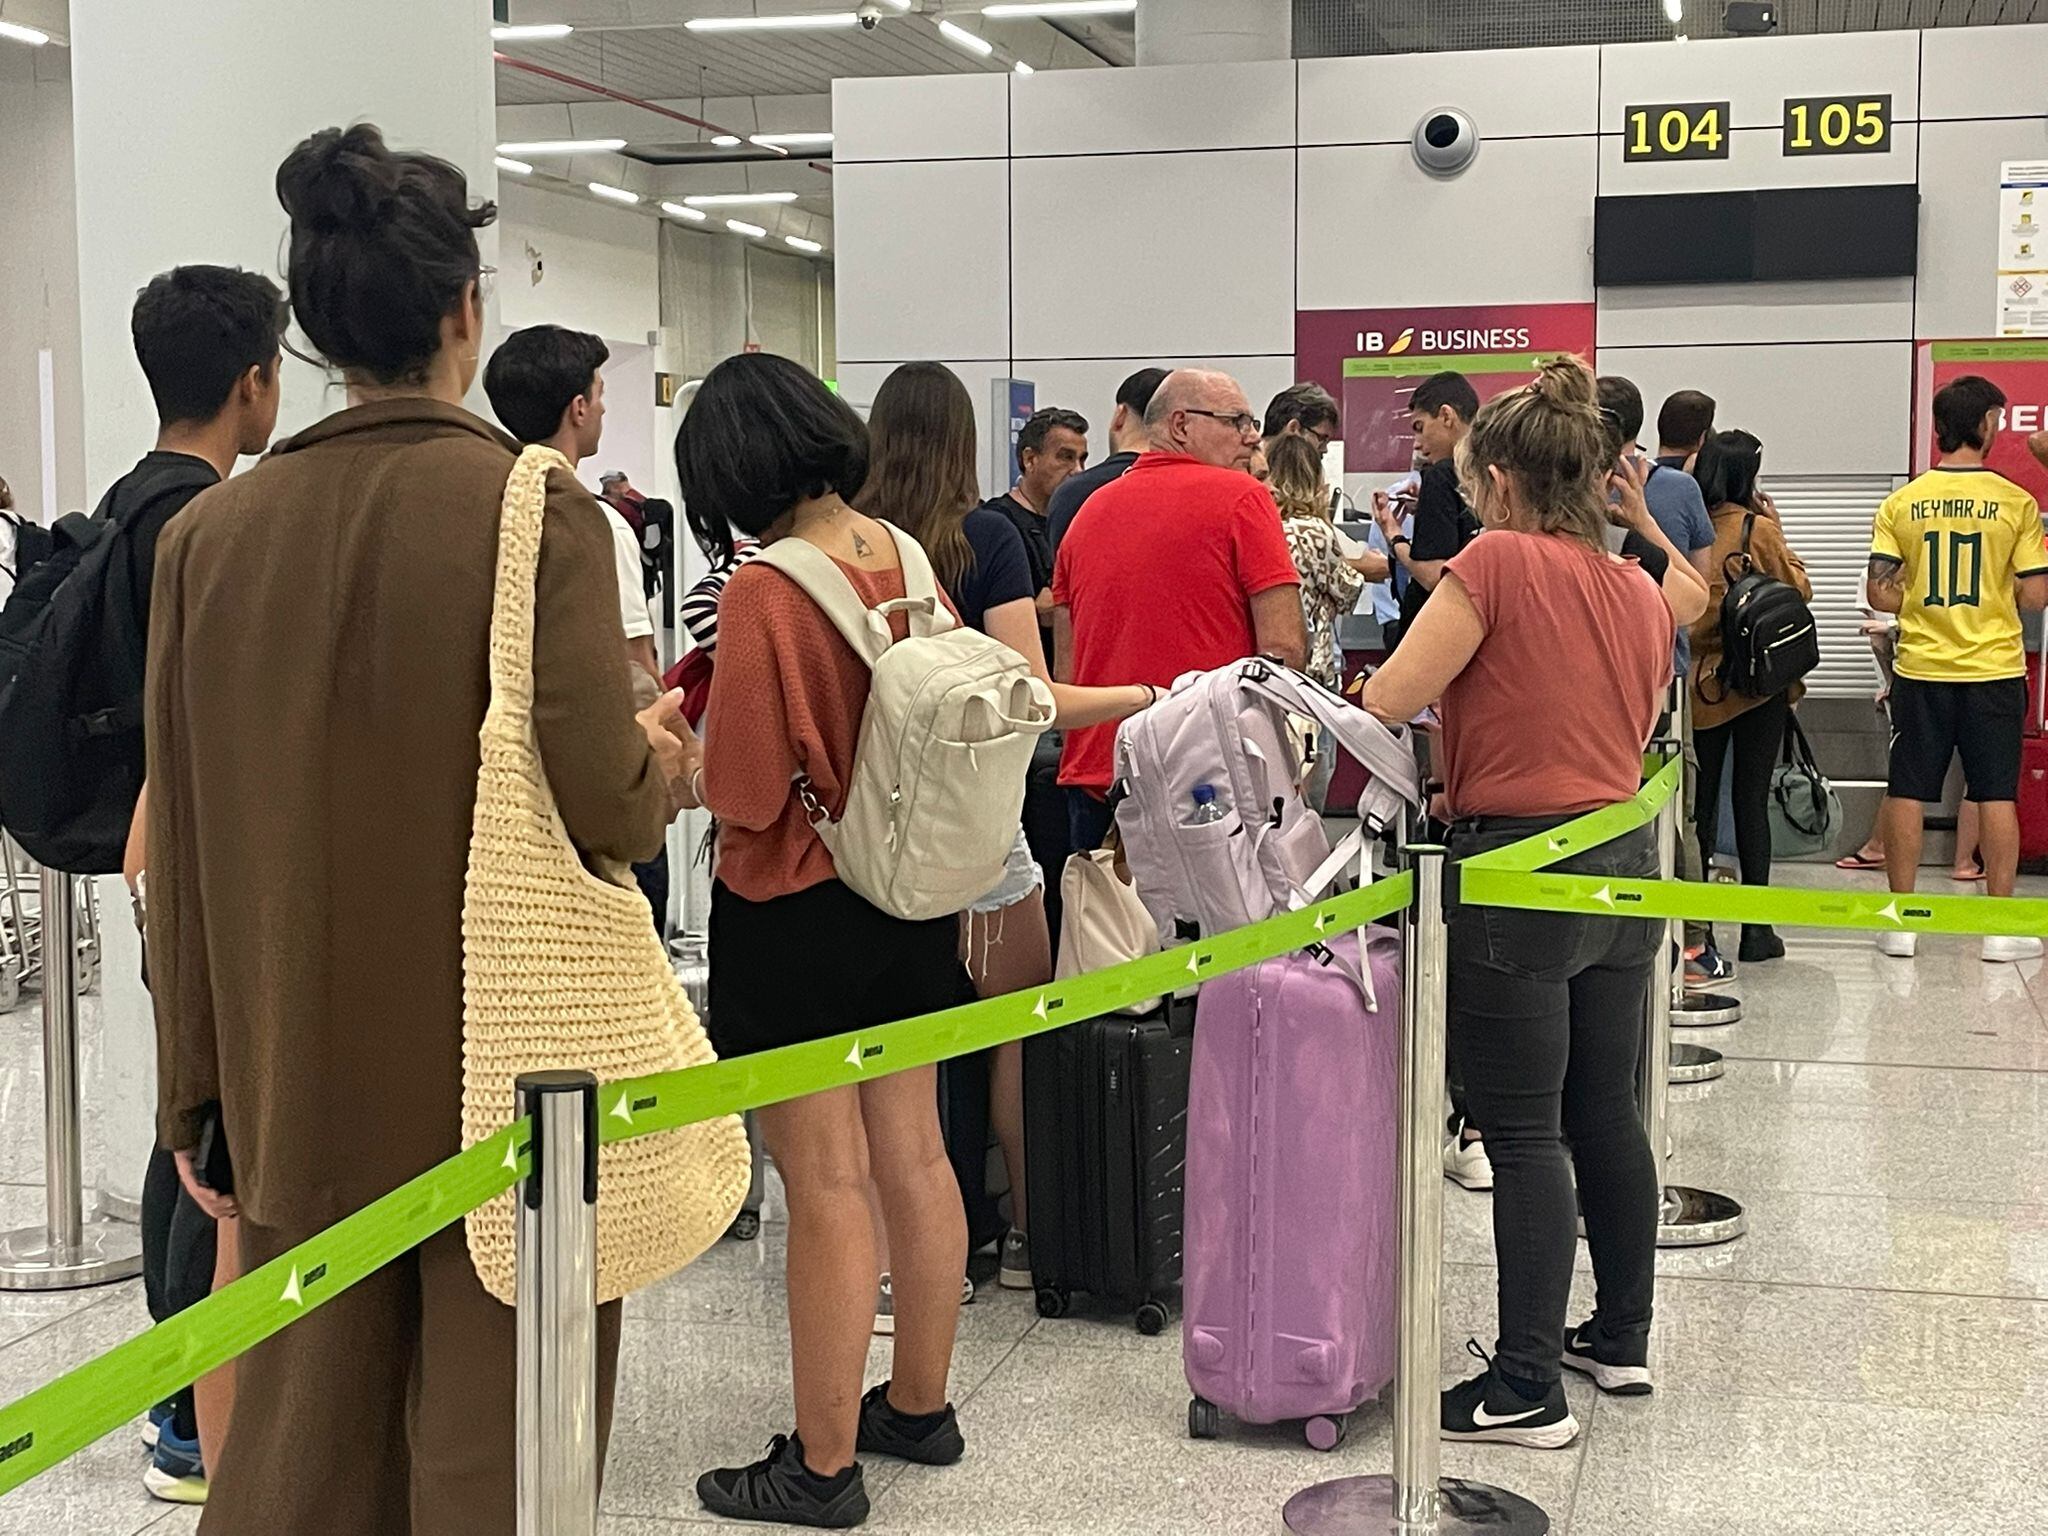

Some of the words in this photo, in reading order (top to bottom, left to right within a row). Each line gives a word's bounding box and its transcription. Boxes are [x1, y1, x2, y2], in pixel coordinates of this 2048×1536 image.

[1630, 108, 1722, 154] 104
[1790, 101, 1884, 148] 105
[1356, 331, 1384, 352] IB
[1421, 328, 1530, 350] BUSINESS
[1911, 499, 1975, 521] NEYMAR
[1977, 500, 1999, 522] JR
[1923, 530, 1982, 608] 10
